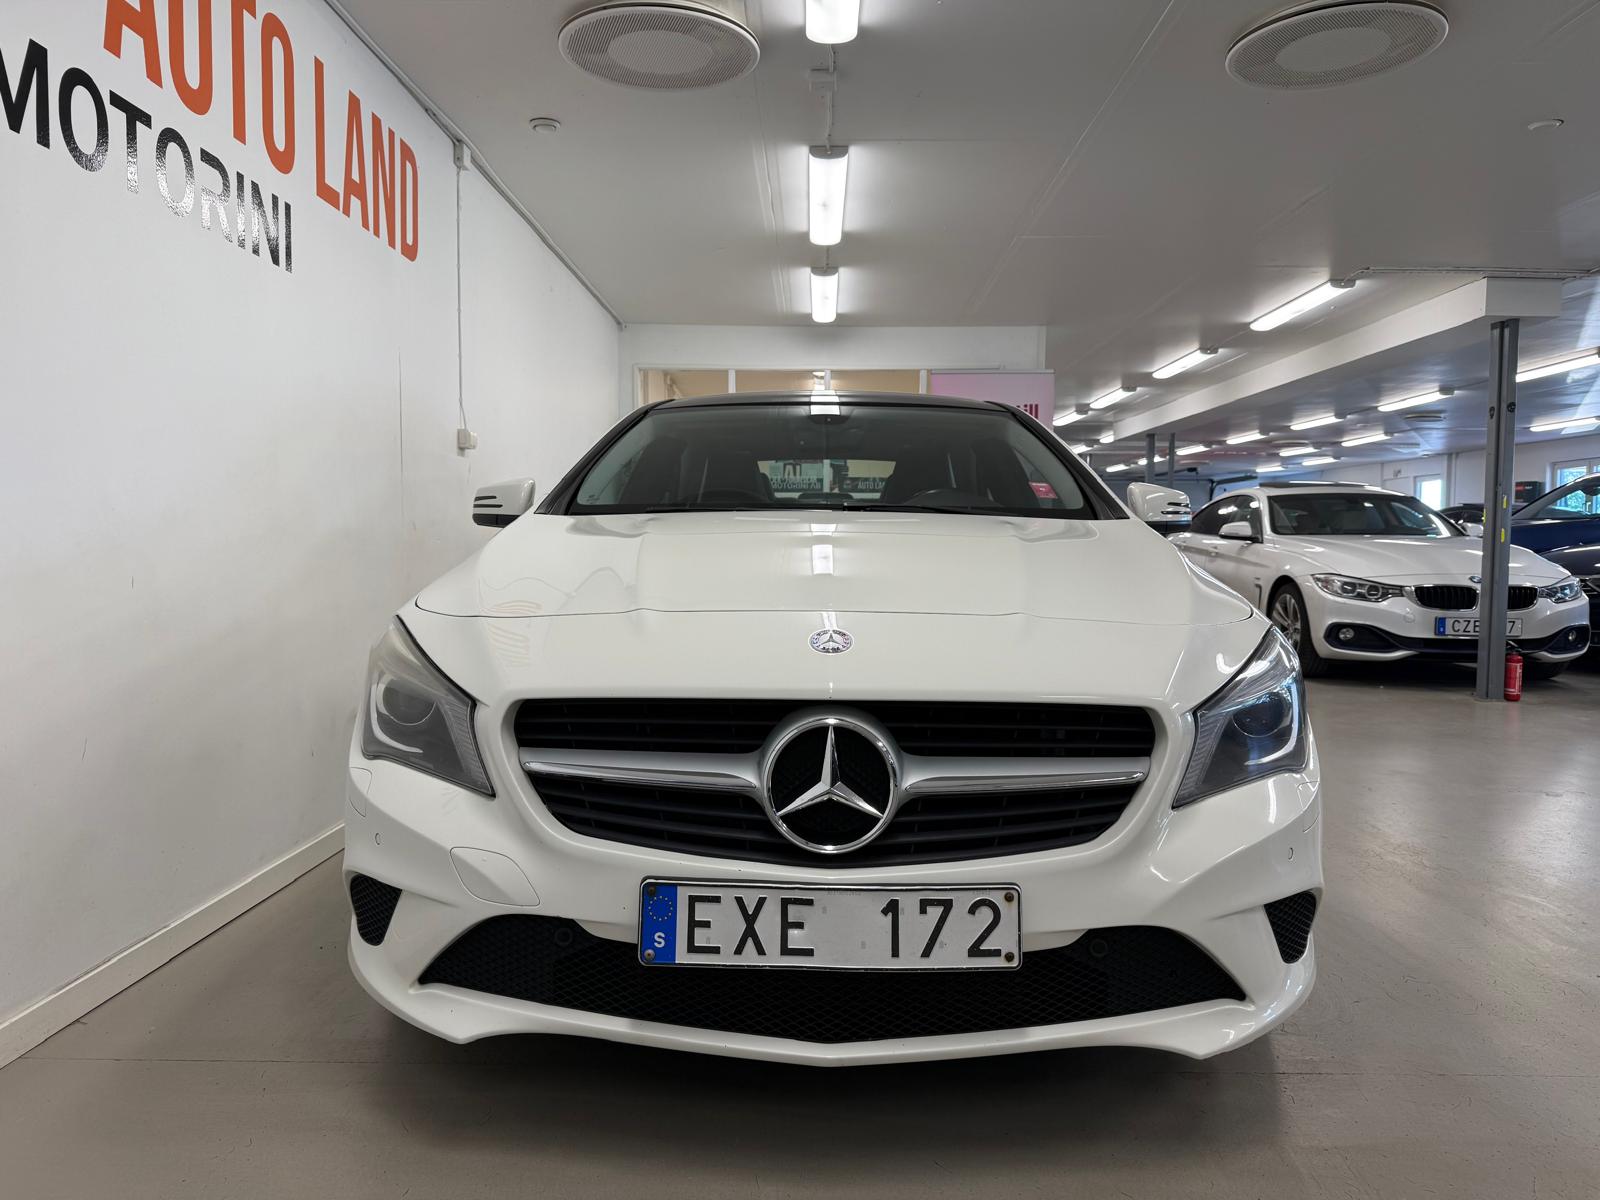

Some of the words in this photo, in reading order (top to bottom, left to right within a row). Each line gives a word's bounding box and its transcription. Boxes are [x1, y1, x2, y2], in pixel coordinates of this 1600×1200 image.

[0, 38, 292, 274] MOTORINI
[314, 55, 419, 262] LAND
[654, 931, 665, 948] S
[686, 894, 815, 957] EXE
[880, 897, 1002, 959] 172
